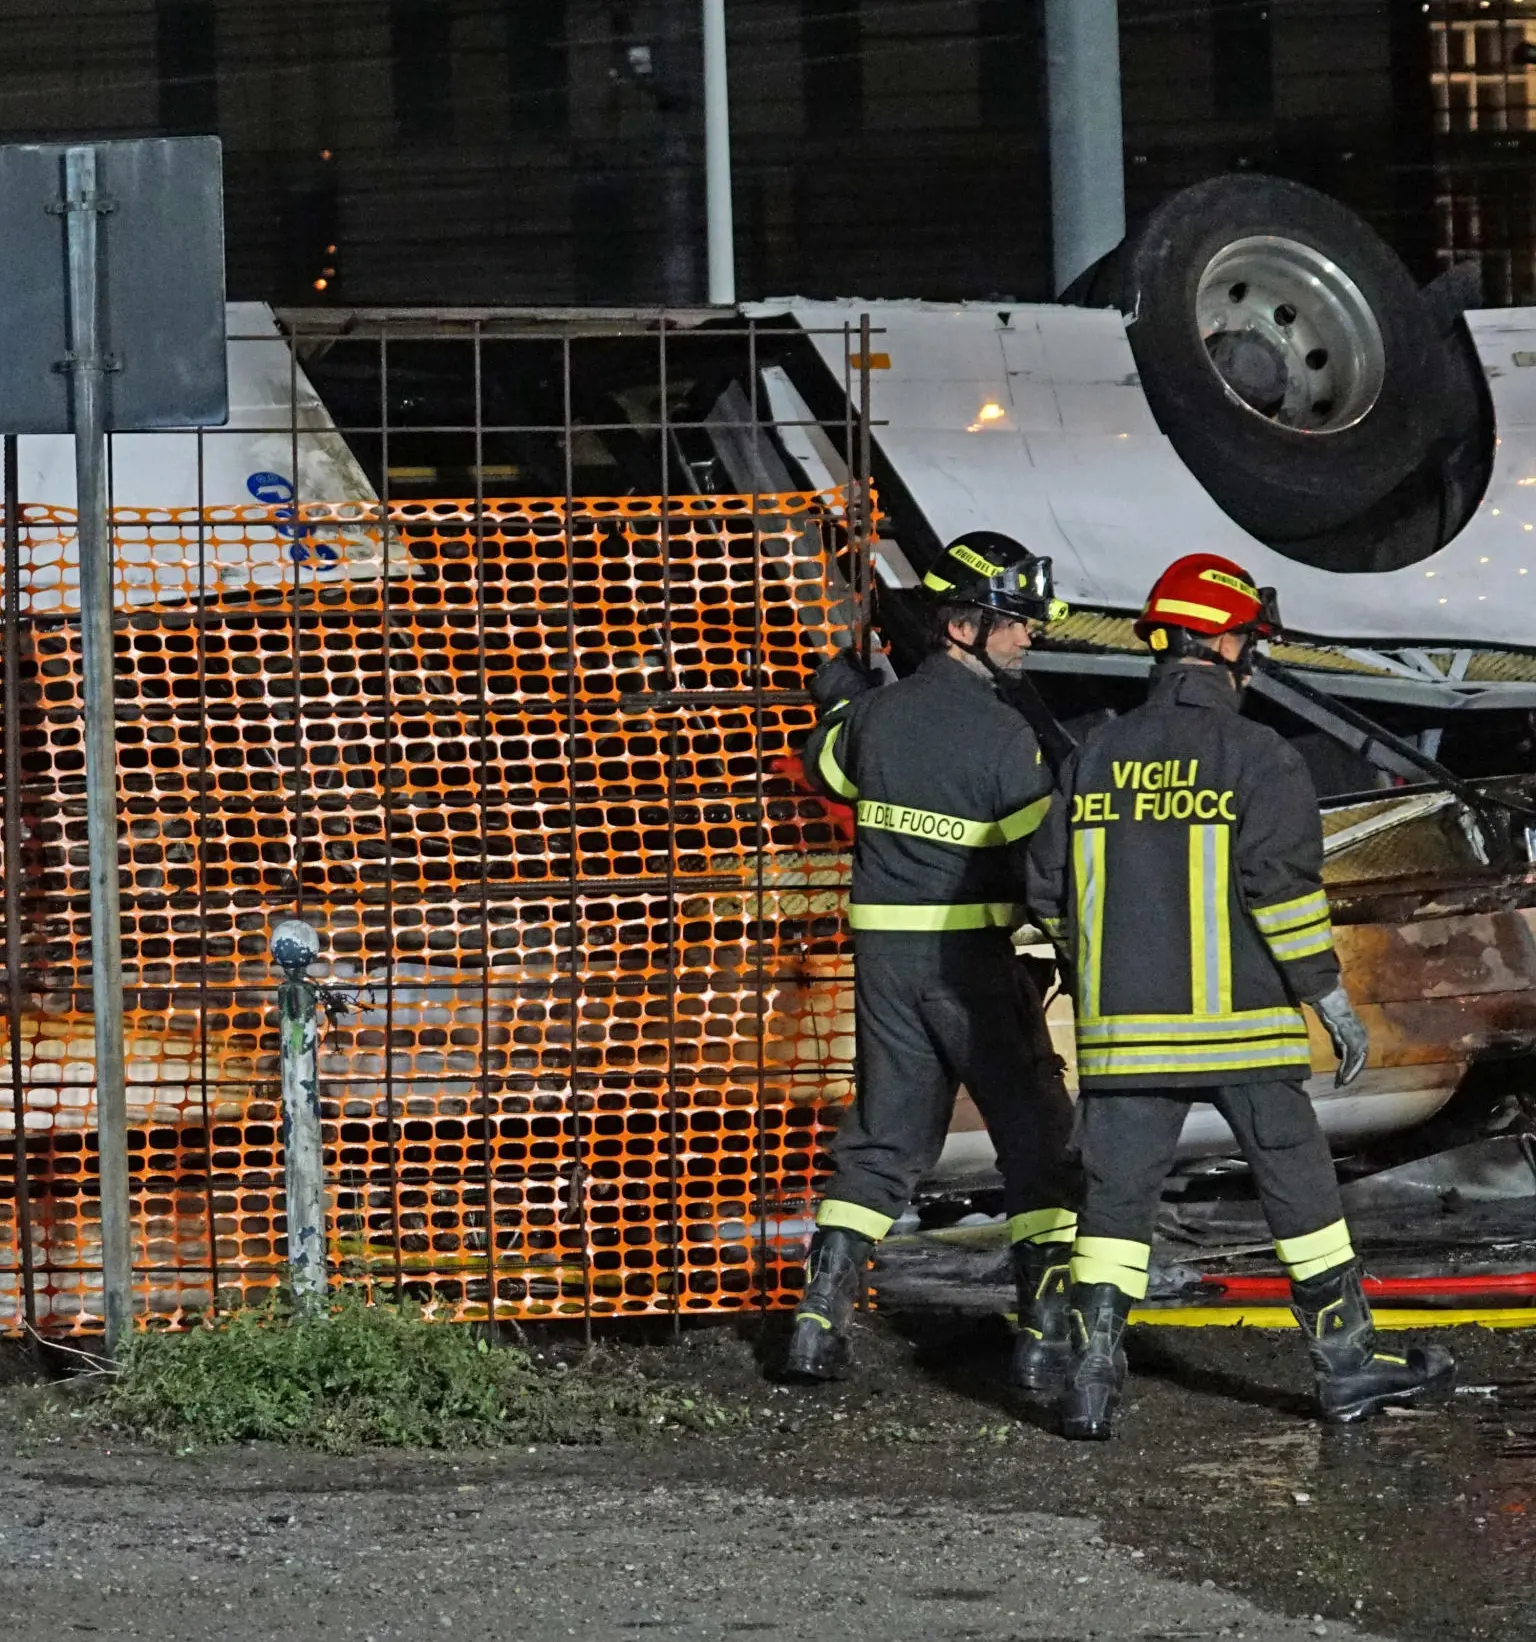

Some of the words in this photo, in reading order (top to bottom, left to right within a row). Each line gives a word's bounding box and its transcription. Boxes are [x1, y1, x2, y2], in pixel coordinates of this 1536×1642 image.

[955, 547, 976, 564] VIGILI
[975, 560, 990, 573] DEL
[1112, 759, 1199, 790] VIGILI
[875, 805, 895, 827] DEL
[899, 811, 965, 840] FUOCO
